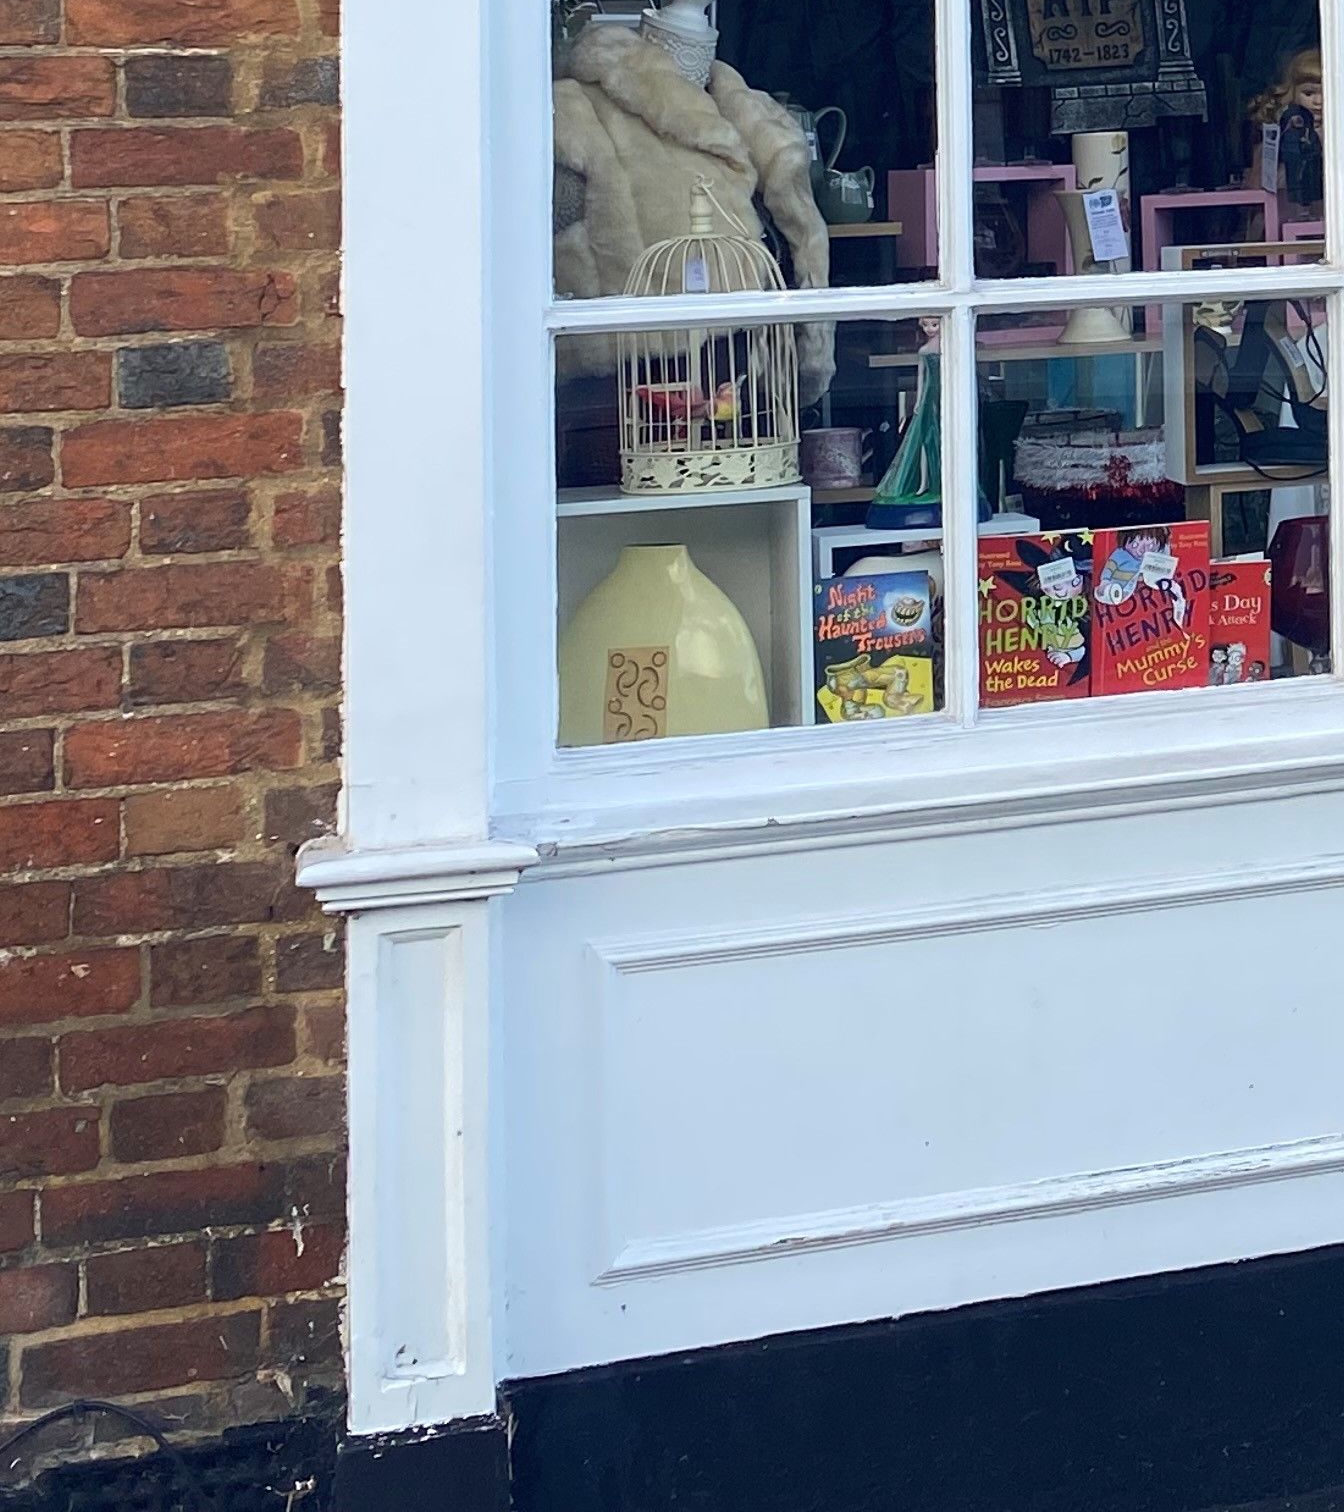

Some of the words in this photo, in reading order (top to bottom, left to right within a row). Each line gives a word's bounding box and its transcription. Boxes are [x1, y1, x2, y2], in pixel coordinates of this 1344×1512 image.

[828, 583, 877, 610] Night
[1223, 595, 1262, 615] Day
[818, 611, 888, 642] Haunted
[851, 628, 926, 653] Trousers
[985, 622, 1080, 657] HENRY
[1105, 598, 1196, 657] HENRY
[985, 654, 1041, 676] Wakes
[1116, 631, 1206, 679] Mummy's
[986, 675, 1014, 693] the
[1017, 669, 1060, 689] Dead
[1142, 655, 1199, 686] Curse
